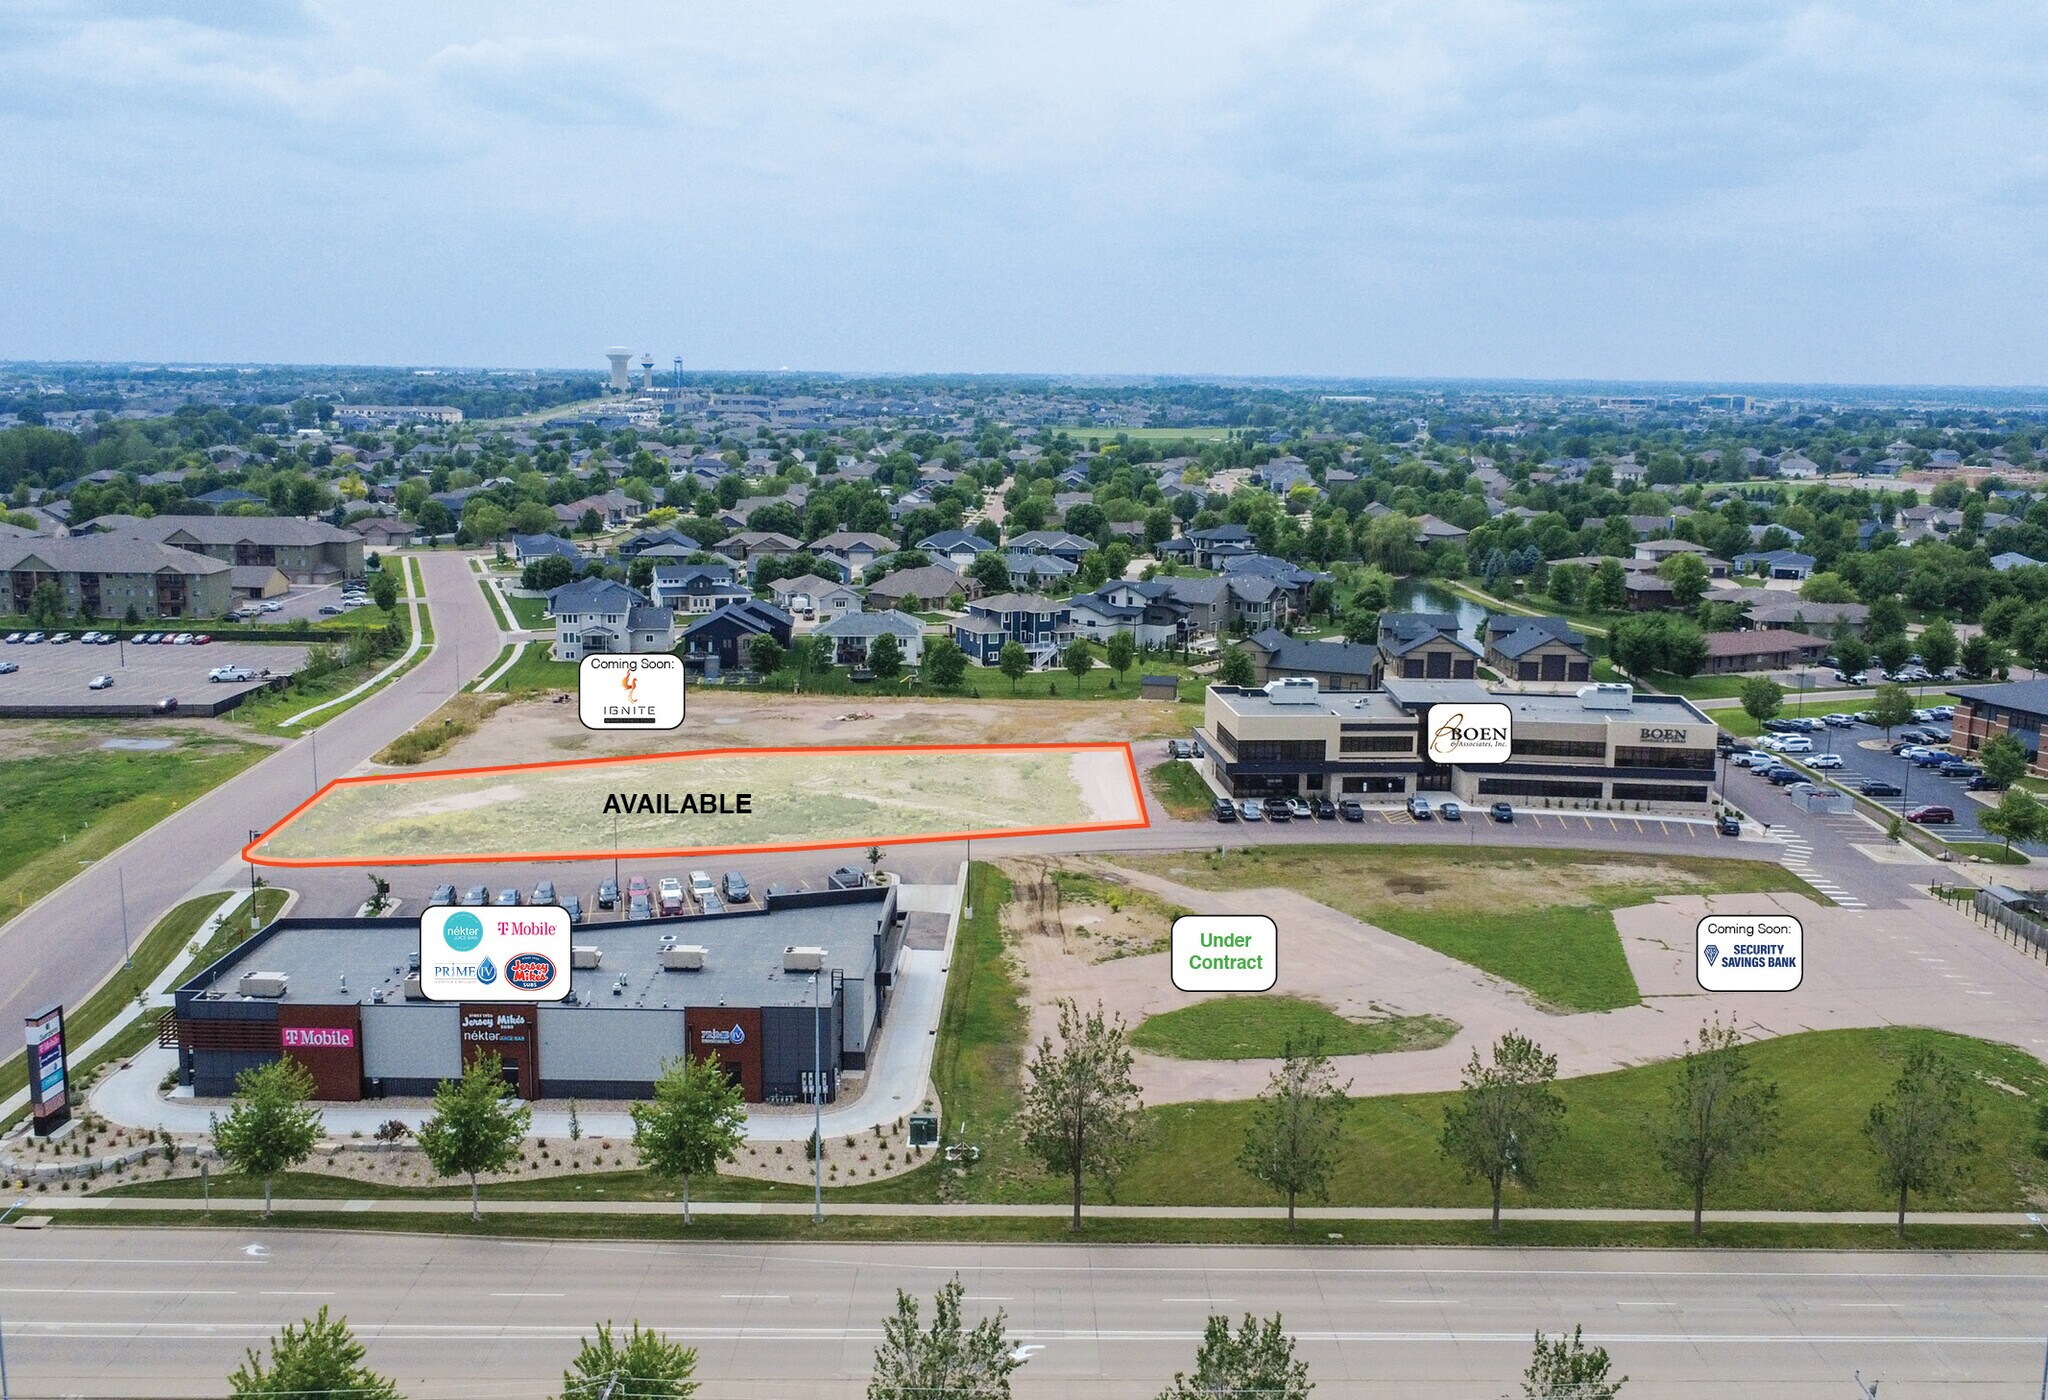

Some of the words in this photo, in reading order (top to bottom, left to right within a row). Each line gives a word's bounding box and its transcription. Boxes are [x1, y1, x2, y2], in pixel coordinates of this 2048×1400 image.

[1640, 728, 1688, 740] BOEN
[462, 1016, 494, 1028] Jersey
[300, 1030, 350, 1046] Mobile
